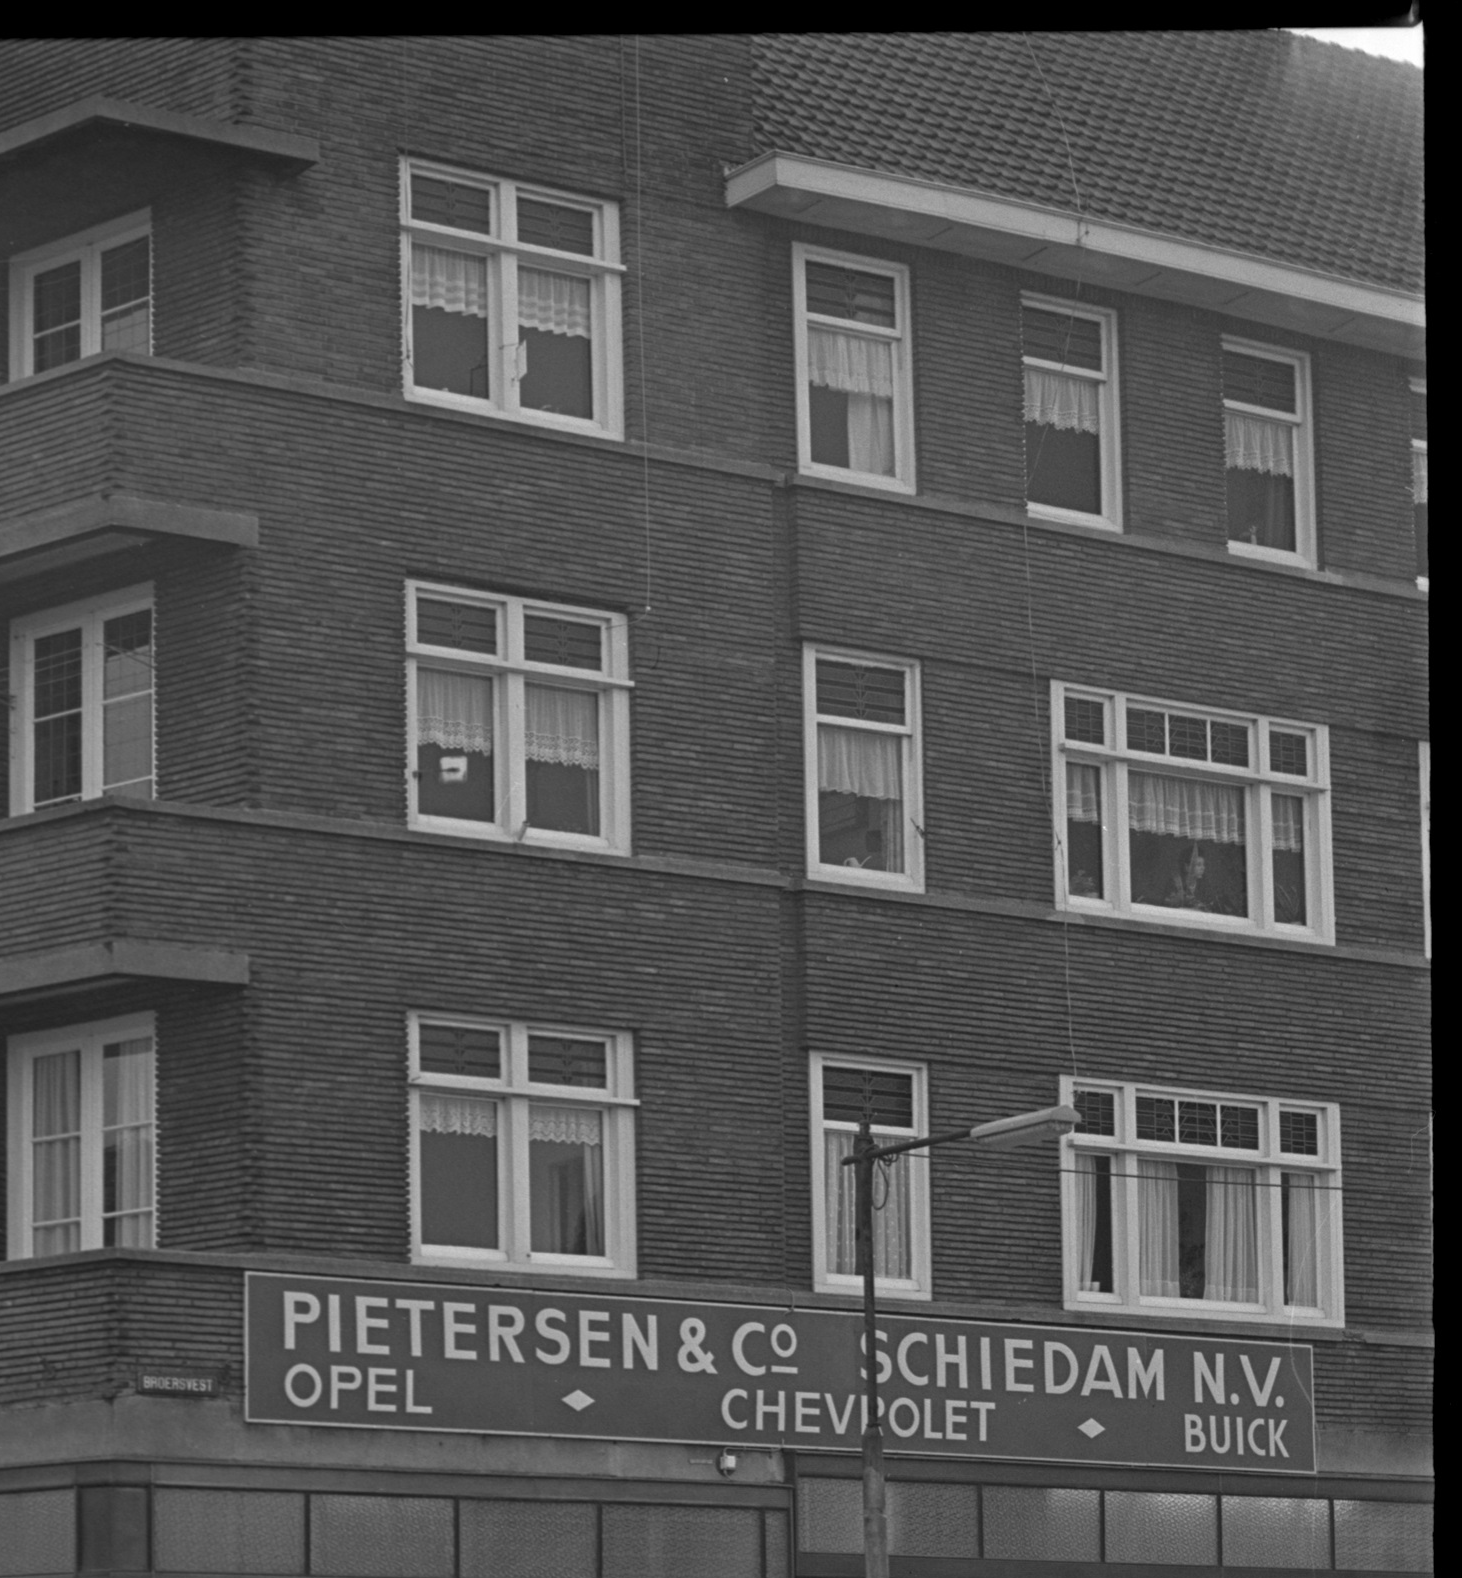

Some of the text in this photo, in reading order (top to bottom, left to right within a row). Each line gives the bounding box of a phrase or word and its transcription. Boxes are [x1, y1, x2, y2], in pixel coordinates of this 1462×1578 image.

[142, 1375, 213, 1392] BROERSVEST
[283, 1290, 659, 1371] PIETERSEN
[677, 1316, 718, 1375] &
[859, 1329, 1165, 1401] SCHIEDAM
[1193, 1351, 1285, 1408] N.V.
[284, 1362, 1290, 1459] OPEL CHEVROLET BUICK
